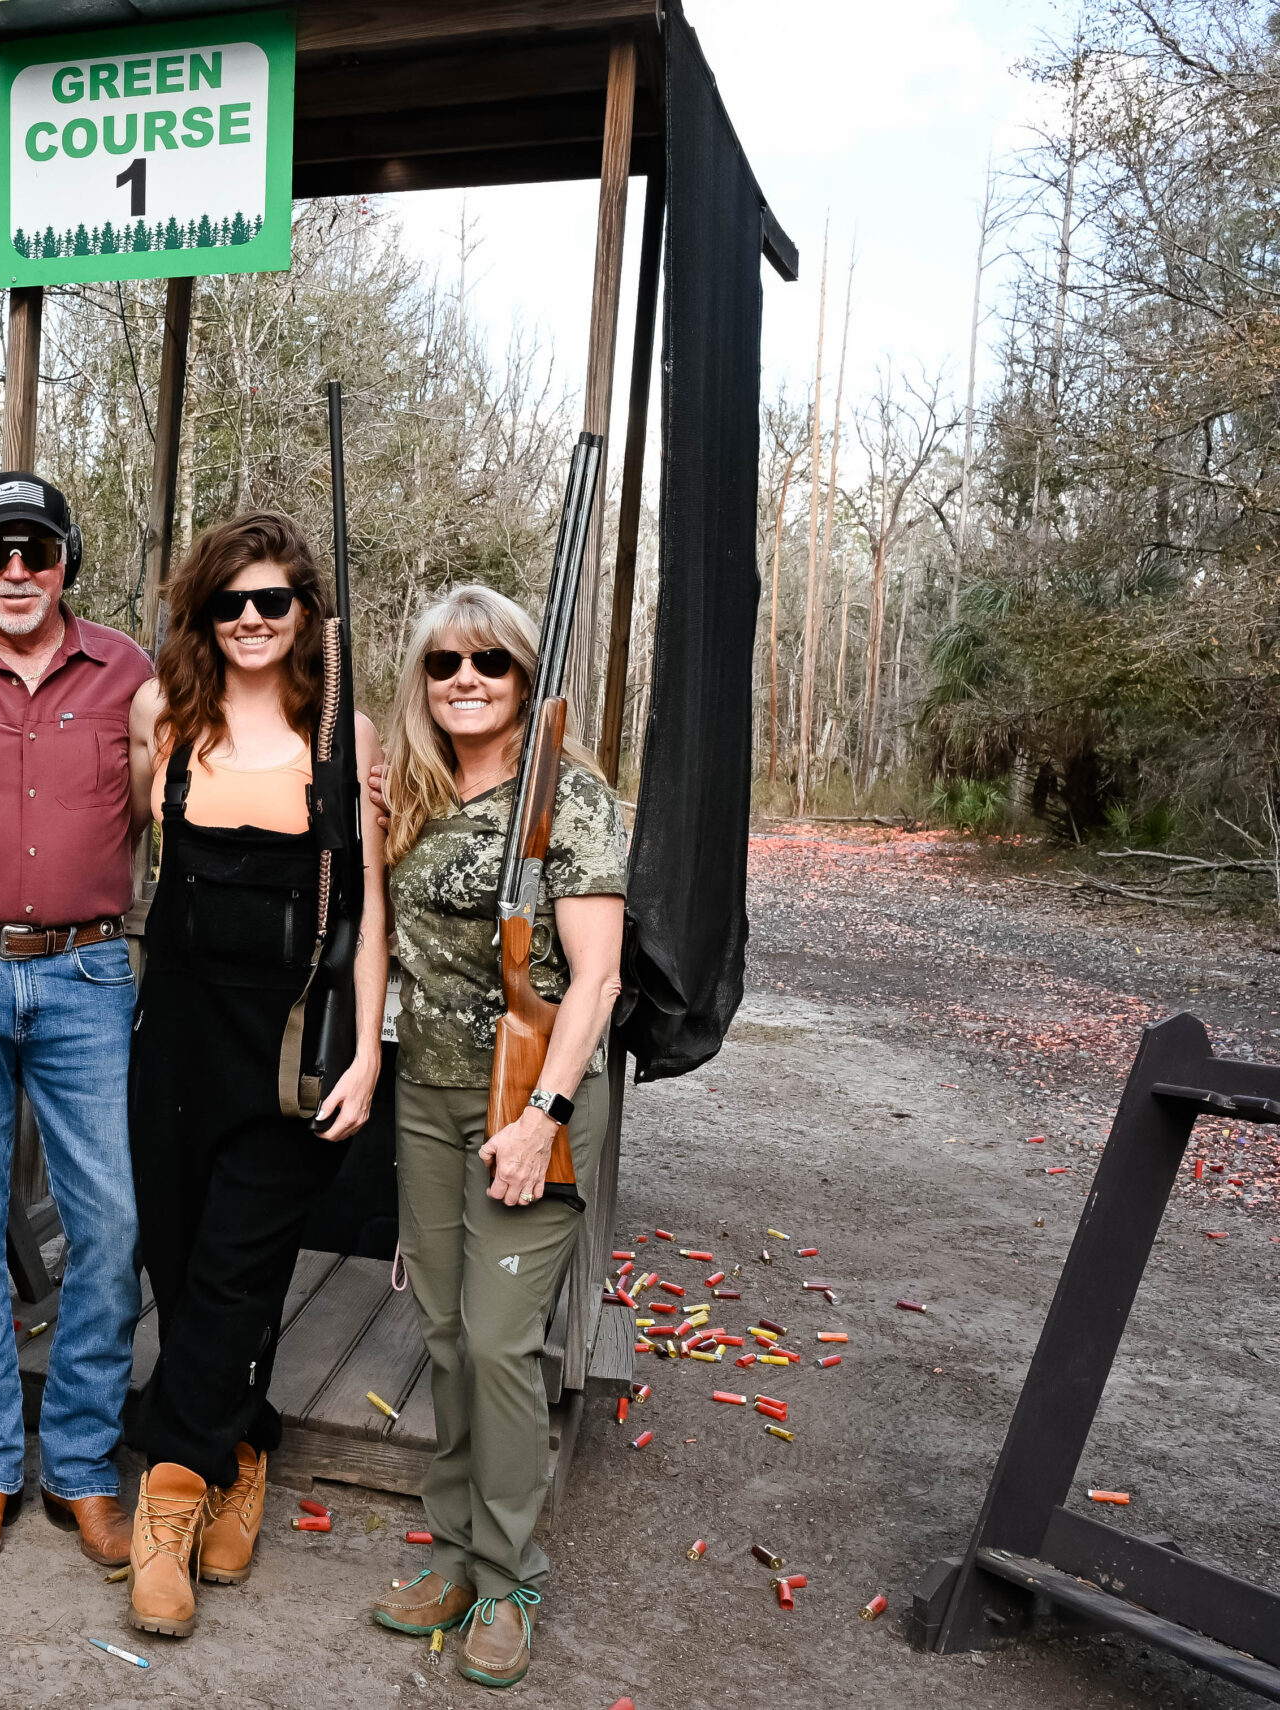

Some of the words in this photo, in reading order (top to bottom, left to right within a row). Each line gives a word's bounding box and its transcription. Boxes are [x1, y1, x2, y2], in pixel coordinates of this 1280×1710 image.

[52, 51, 222, 104] GREEN
[25, 102, 251, 162] COURSE
[116, 158, 147, 217] 1
